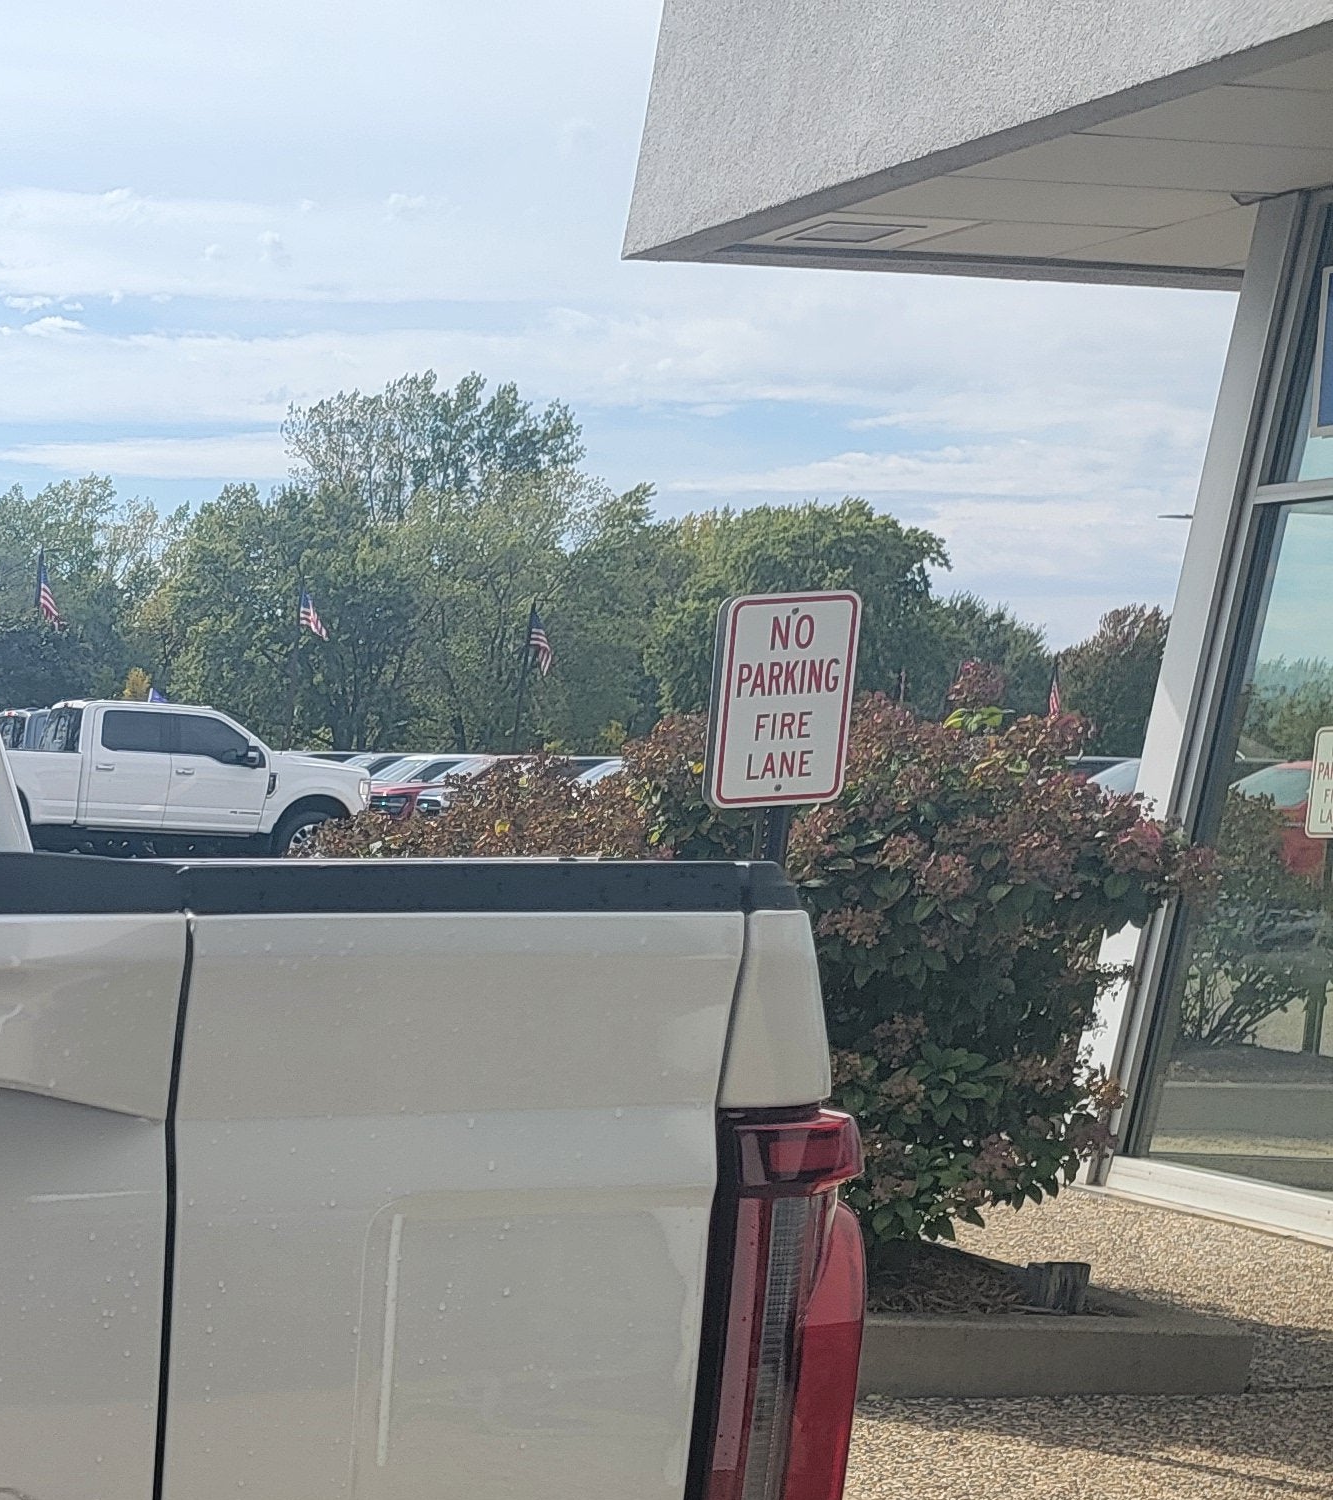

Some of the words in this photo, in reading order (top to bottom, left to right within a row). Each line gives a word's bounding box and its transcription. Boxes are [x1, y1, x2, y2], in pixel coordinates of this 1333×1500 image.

[770, 614, 815, 651] NO
[736, 658, 840, 698] PARKING
[754, 711, 813, 741] FIRE
[746, 750, 813, 780] LANE
